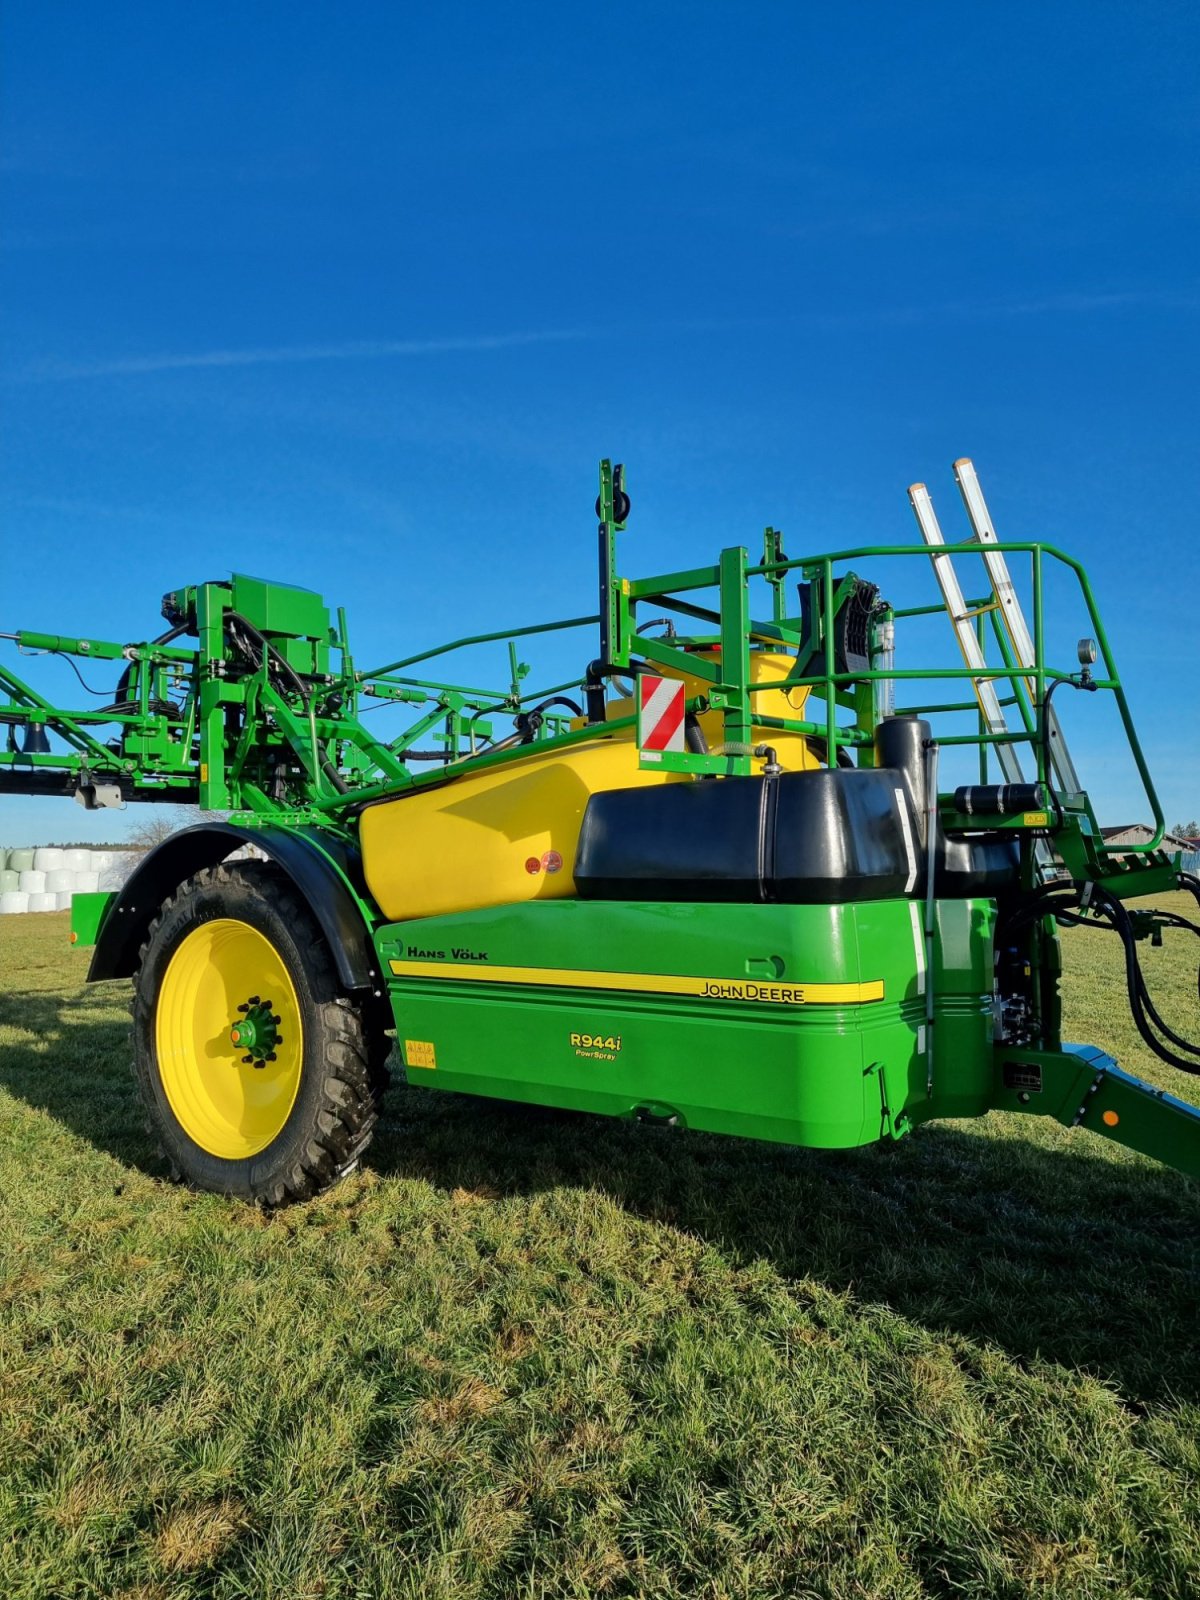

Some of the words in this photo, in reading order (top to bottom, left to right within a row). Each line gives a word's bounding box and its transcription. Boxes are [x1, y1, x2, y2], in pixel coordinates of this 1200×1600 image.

[407, 946, 446, 959] HANS
[451, 948, 489, 961] VÖLK
[700, 981, 743, 998] JOHN
[745, 984, 805, 1002] DEERE
[570, 1032, 621, 1051] R944i
[575, 1049, 616, 1061] PowrSpray
